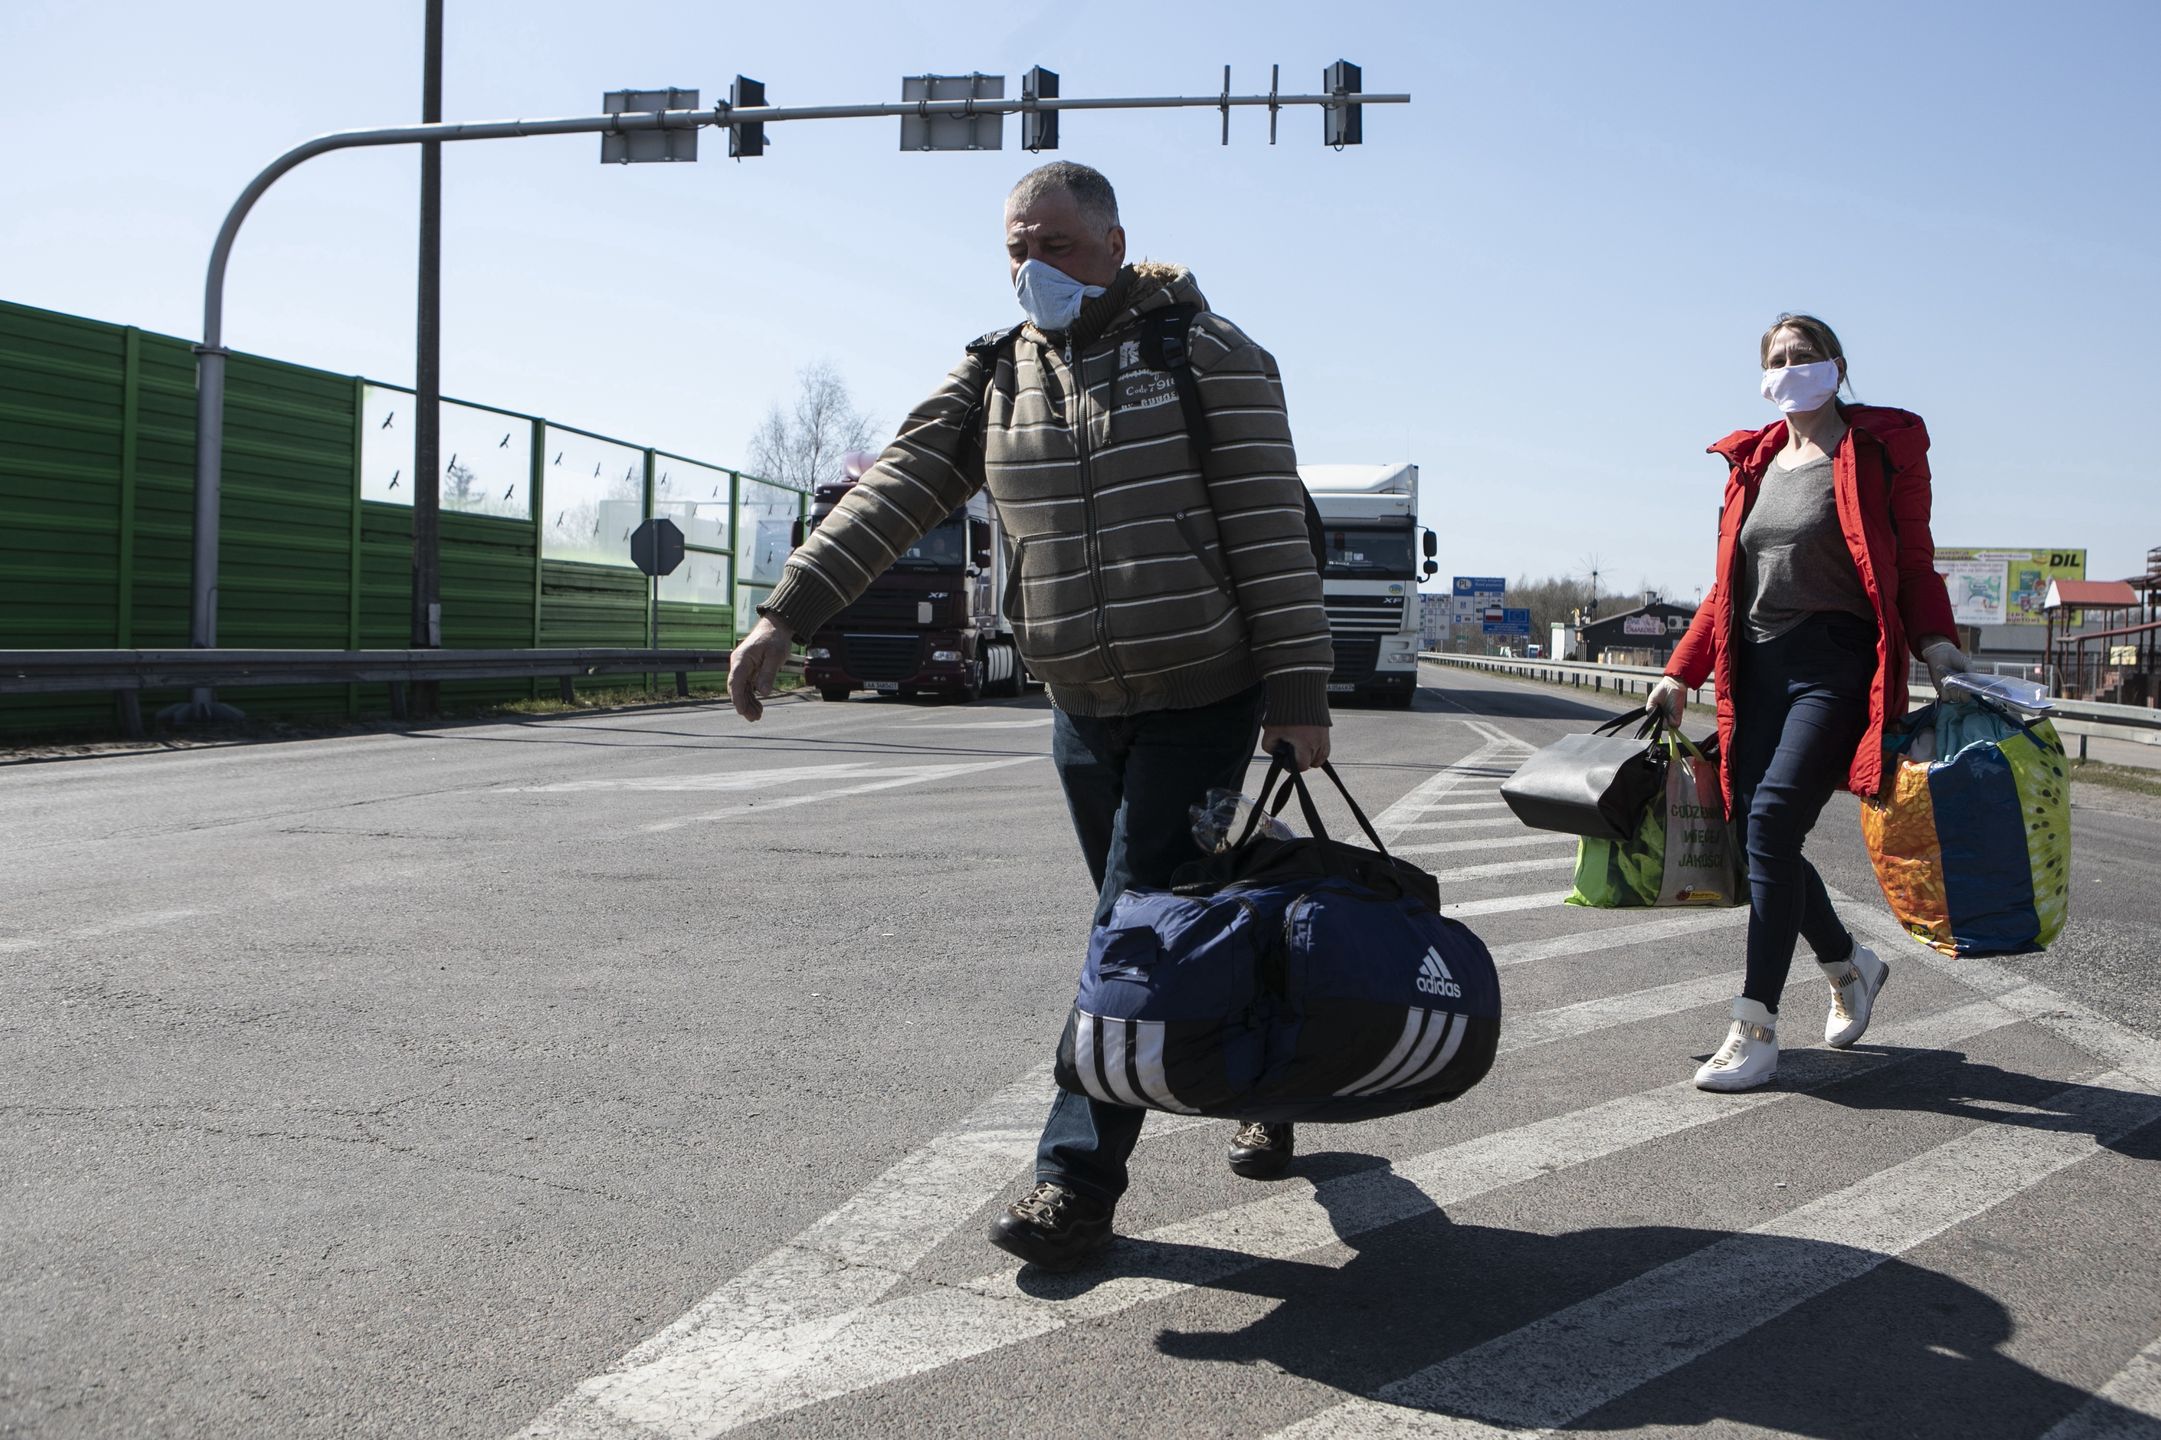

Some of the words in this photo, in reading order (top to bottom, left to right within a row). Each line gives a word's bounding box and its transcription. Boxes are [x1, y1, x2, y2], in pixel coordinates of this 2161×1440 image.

[2049, 553, 2081, 568] DIL
[1459, 580, 1468, 588] PL
[928, 591, 949, 599] XF
[1415, 976, 1462, 999] adidas
